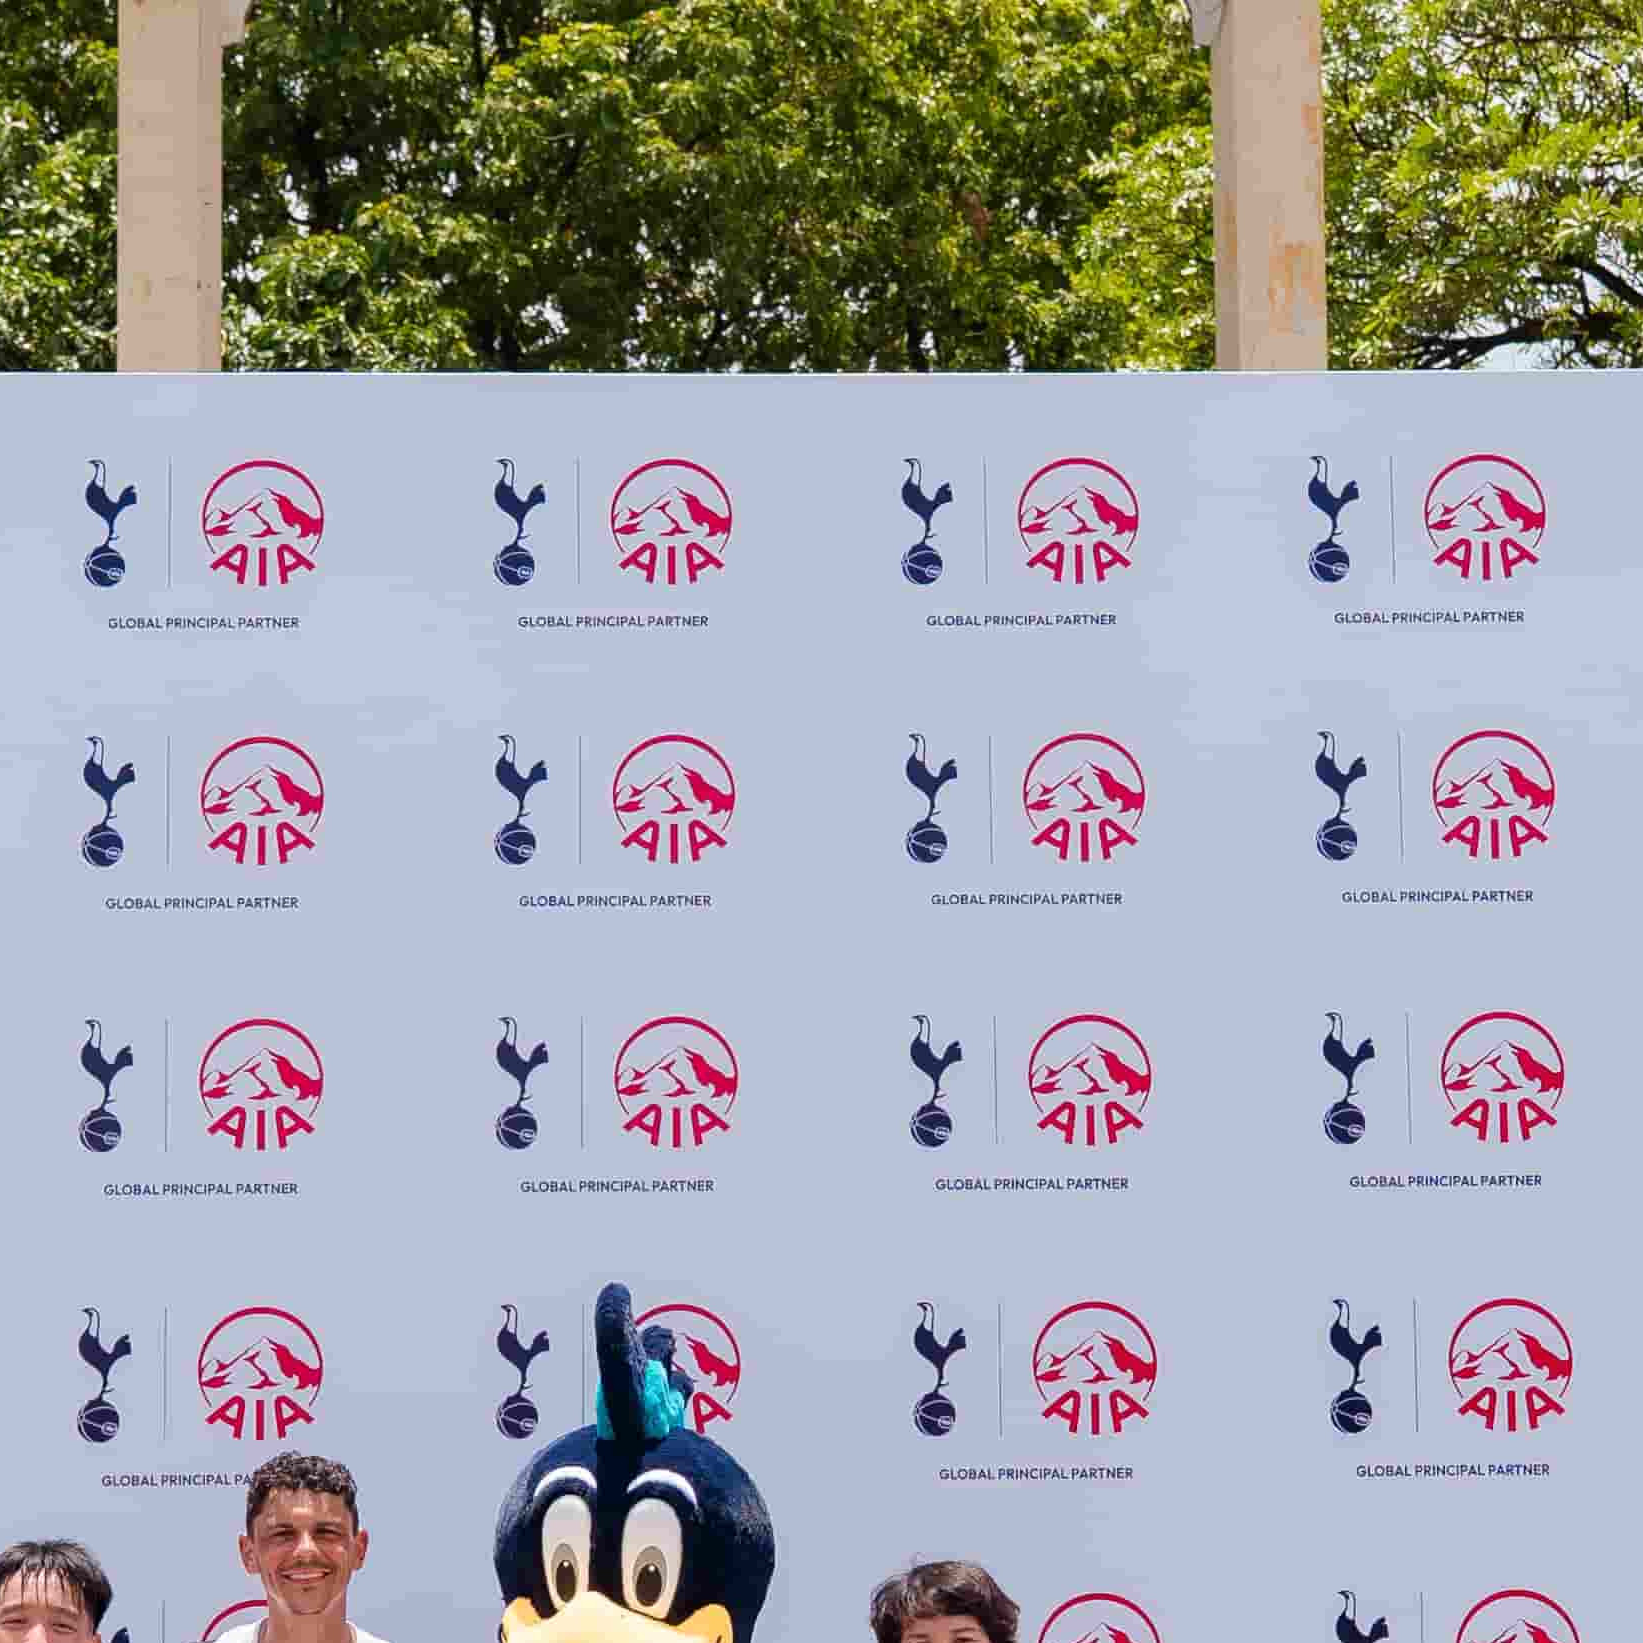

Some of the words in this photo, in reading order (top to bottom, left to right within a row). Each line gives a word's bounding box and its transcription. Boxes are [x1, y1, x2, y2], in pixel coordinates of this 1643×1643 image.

[210, 543, 317, 586] AIA
[618, 542, 725, 585] AIA
[1027, 540, 1133, 585] AIA
[926, 615, 982, 627] GLOBAL
[983, 615, 1054, 628] PRINCIPAL
[1055, 613, 1117, 625] PARTNER
[620, 819, 727, 865] AIA
[519, 895, 575, 907] GLOBAL
[577, 895, 648, 907] PRINCIPAL
[650, 895, 712, 907] PARTNER
[1450, 1097, 1559, 1144] AIA
[1349, 1175, 1405, 1188] GLOBAL
[1407, 1175, 1478, 1187] PRINCIPAL
[1480, 1174, 1542, 1187] PARTNER
[1042, 1389, 1151, 1436] AIA
[938, 1467, 995, 1481] GLOBAL
[997, 1467, 1069, 1481] PRINCIPAL
[1071, 1467, 1134, 1481] PARTNER
